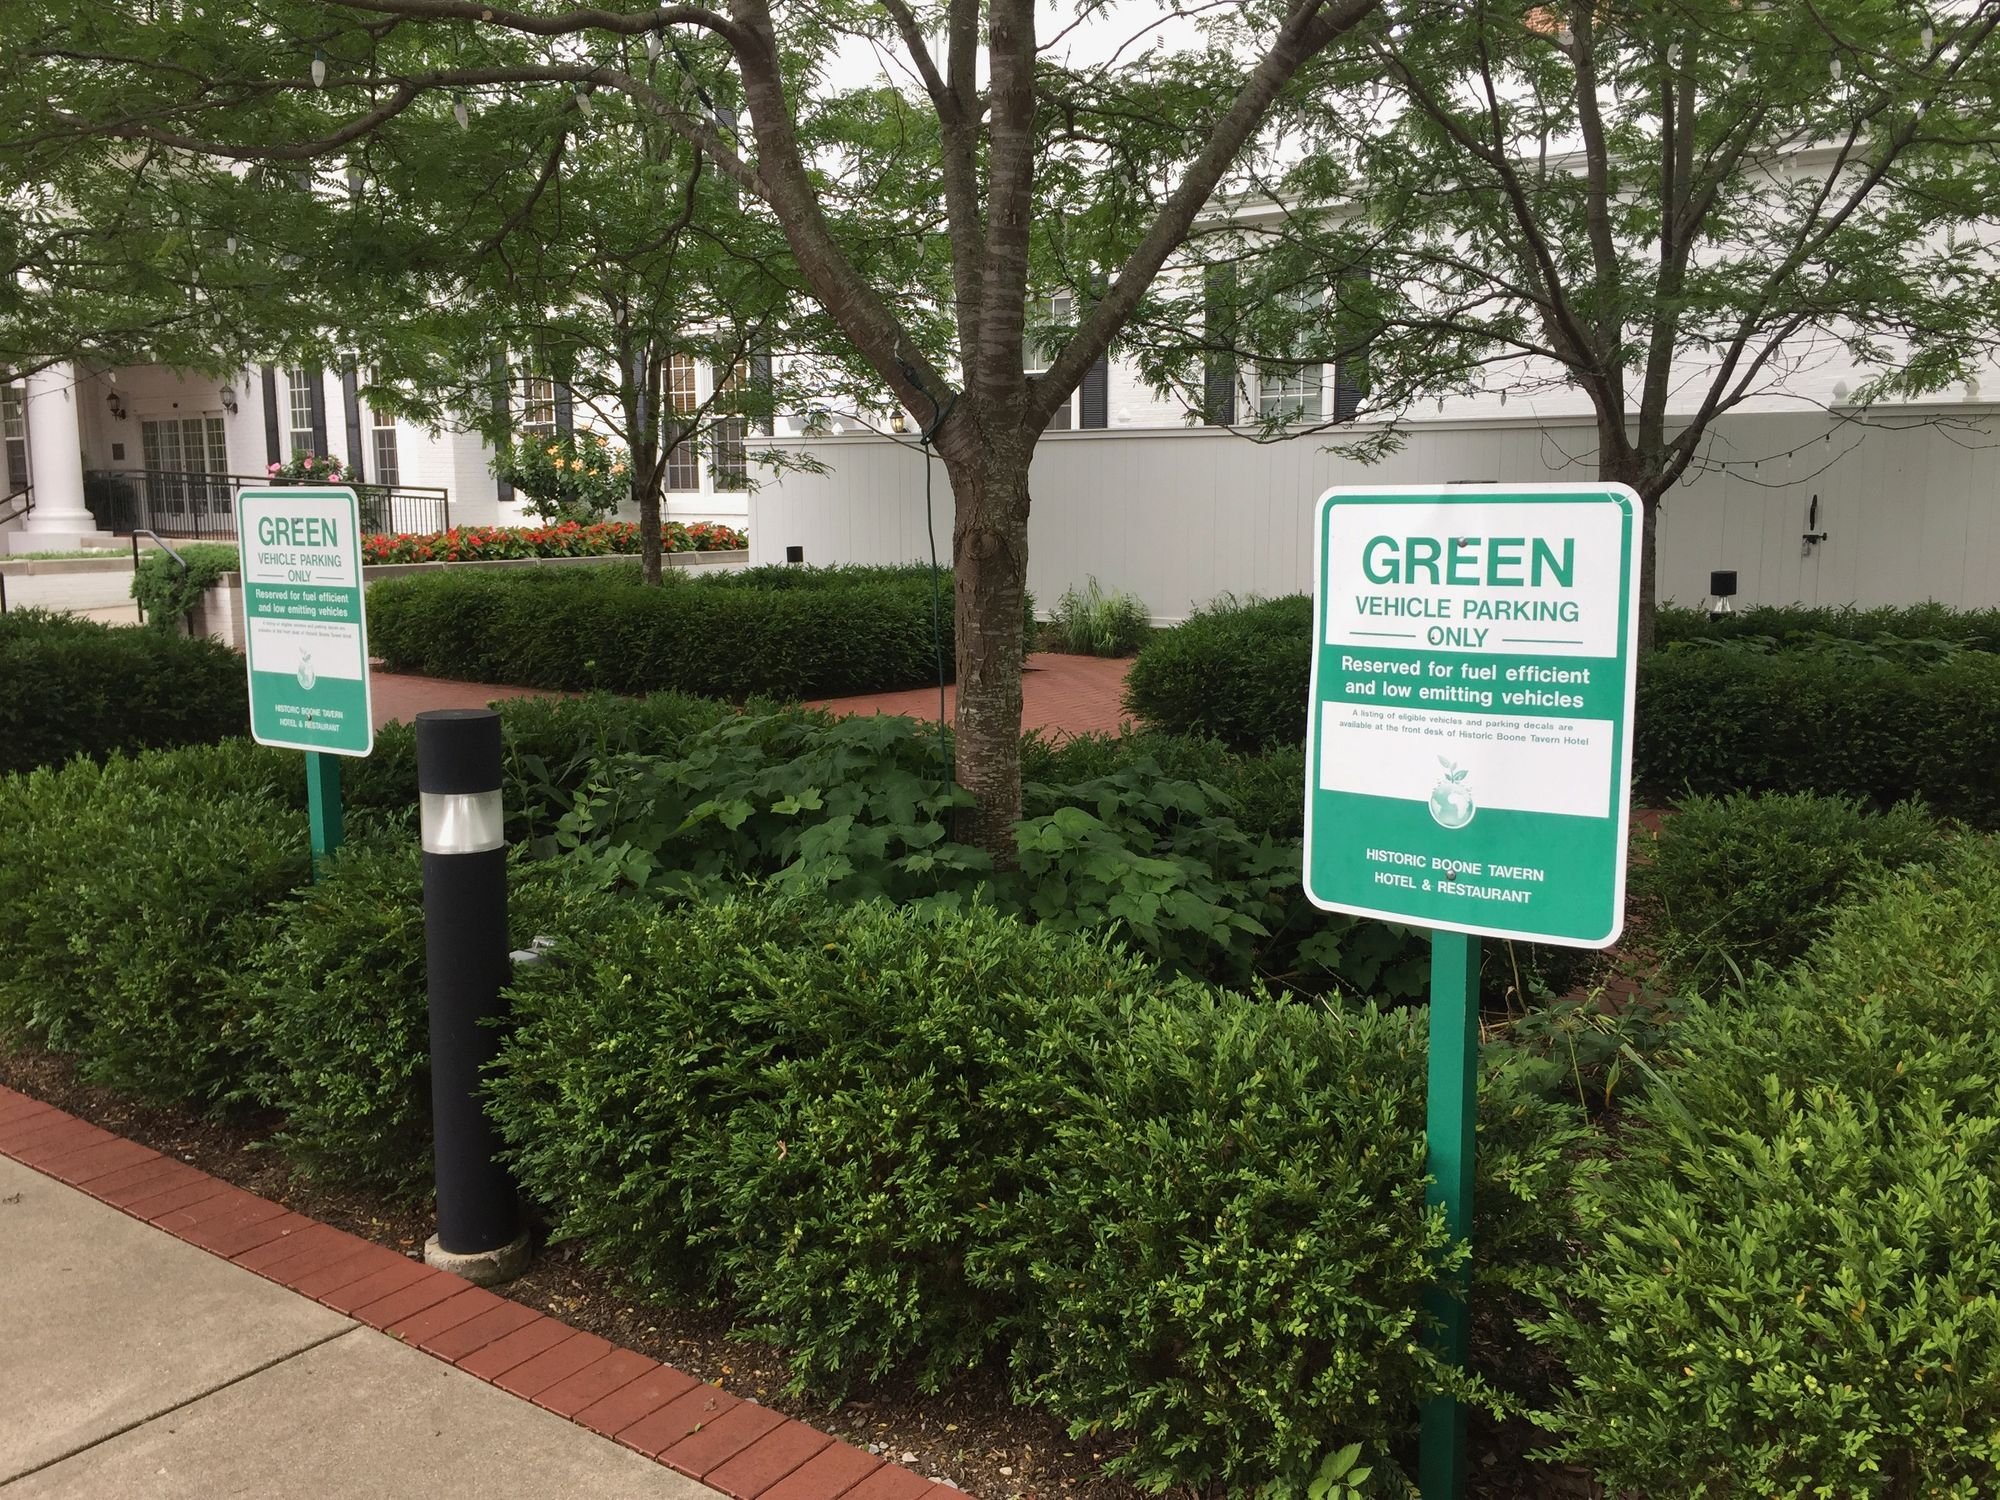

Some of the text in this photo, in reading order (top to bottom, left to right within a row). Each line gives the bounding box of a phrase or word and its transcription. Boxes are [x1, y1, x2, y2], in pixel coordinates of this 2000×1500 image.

[258, 516, 338, 547] GREEN
[257, 552, 342, 567] VEHICLE PARKING
[1362, 535, 1575, 588] GREEN
[287, 569, 311, 582] ONLY
[255, 588, 349, 603] Reserved for fuel efficient
[1355, 595, 1580, 622] VEHICLE PARKING
[258, 603, 348, 617] and low emitting vehicles
[1427, 625, 1489, 648] ONLY
[1341, 655, 1591, 685] Reserved for fuel efficient
[1345, 680, 1584, 708] and low emitting vehicles
[1339, 720, 1373, 730] available
[1375, 723, 1383, 731] at
[1386, 724, 1399, 732] the
[1401, 725, 1421, 734] front
[1424, 727, 1444, 736] desk
[1459, 730, 1493, 740] Historic
[1496, 732, 1526, 742] Boone
[1530, 734, 1560, 744] Tavern
[1563, 736, 1589, 746] Hotel
[1360, 710, 1384, 720] listing
[1398, 714, 1427, 723] eligible
[1429, 716, 1462, 725] vehicles
[1485, 720, 1520, 730] parking
[1523, 721, 1554, 730] decals
[1366, 848, 1545, 882] HISTORIC BOONE TAVERN
[1374, 871, 1532, 903] HOTEL & RESTAURANT
